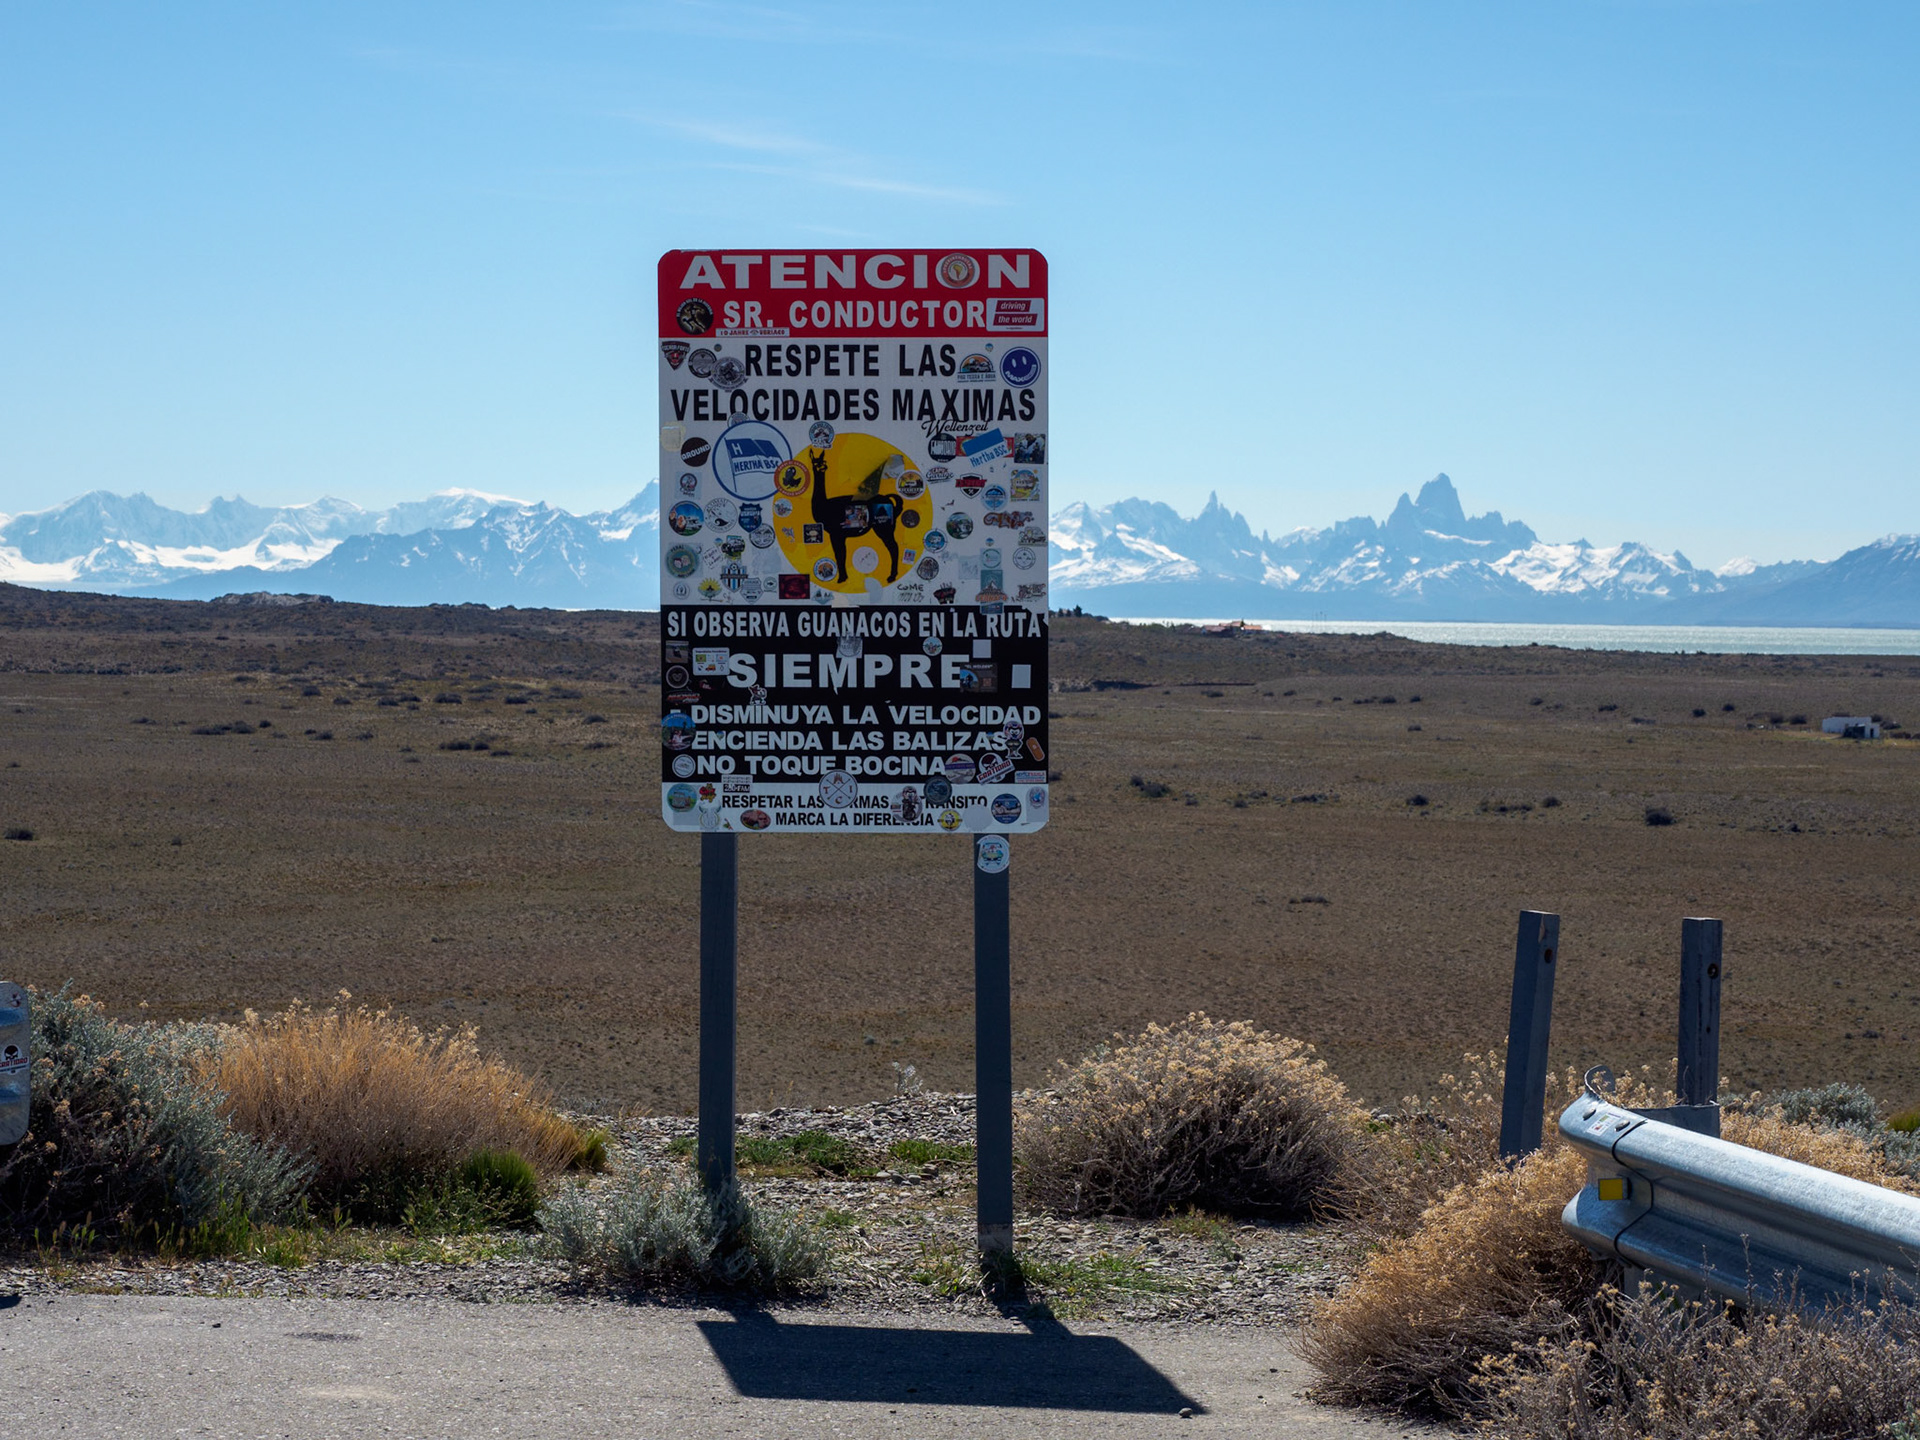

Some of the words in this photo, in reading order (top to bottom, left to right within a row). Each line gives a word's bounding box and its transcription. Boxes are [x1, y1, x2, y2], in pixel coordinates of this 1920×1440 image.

[679, 254, 1030, 289] ATENCION
[723, 300, 773, 329] SR.
[789, 300, 986, 329] CONDUCTOR
[1000, 301, 1026, 311] driving
[998, 315, 1010, 323] the
[1011, 315, 1033, 323] world
[745, 344, 879, 377] RESPETE
[899, 344, 956, 377] LAS
[671, 388, 880, 422] VELOCIDADES
[892, 388, 1036, 422] MAXIMAS
[733, 458, 764, 473] HERTHA
[970, 450, 996, 468] Hertha
[993, 444, 1008, 458] BSC
[667, 611, 687, 637] SI
[693, 611, 790, 637] OBSERVA
[797, 611, 911, 637] GUANACOS
[918, 611, 945, 637] EN
[952, 611, 979, 637] LA
[986, 611, 1042, 637] RUTA
[726, 652, 970, 689] SIEMPRE
[691, 705, 834, 725] DISMINUYA
[842, 705, 880, 725] LA
[889, 705, 1041, 725] VELOCIDAD
[691, 730, 823, 750] ENCIENDA
[832, 730, 885, 751] LAS
[893, 730, 1007, 751] BALIZAS
[697, 755, 736, 775] NO
[744, 755, 836, 775] TOQUE
[845, 755, 946, 776] BOCINA
[722, 795, 793, 809] RESPETAR
[798, 795, 825, 809] LAS
[850, 795, 890, 809] RMAS
[775, 812, 826, 826] MARCA
[830, 812, 849, 826] LA
[853, 812, 934, 826] DIFEREIA
